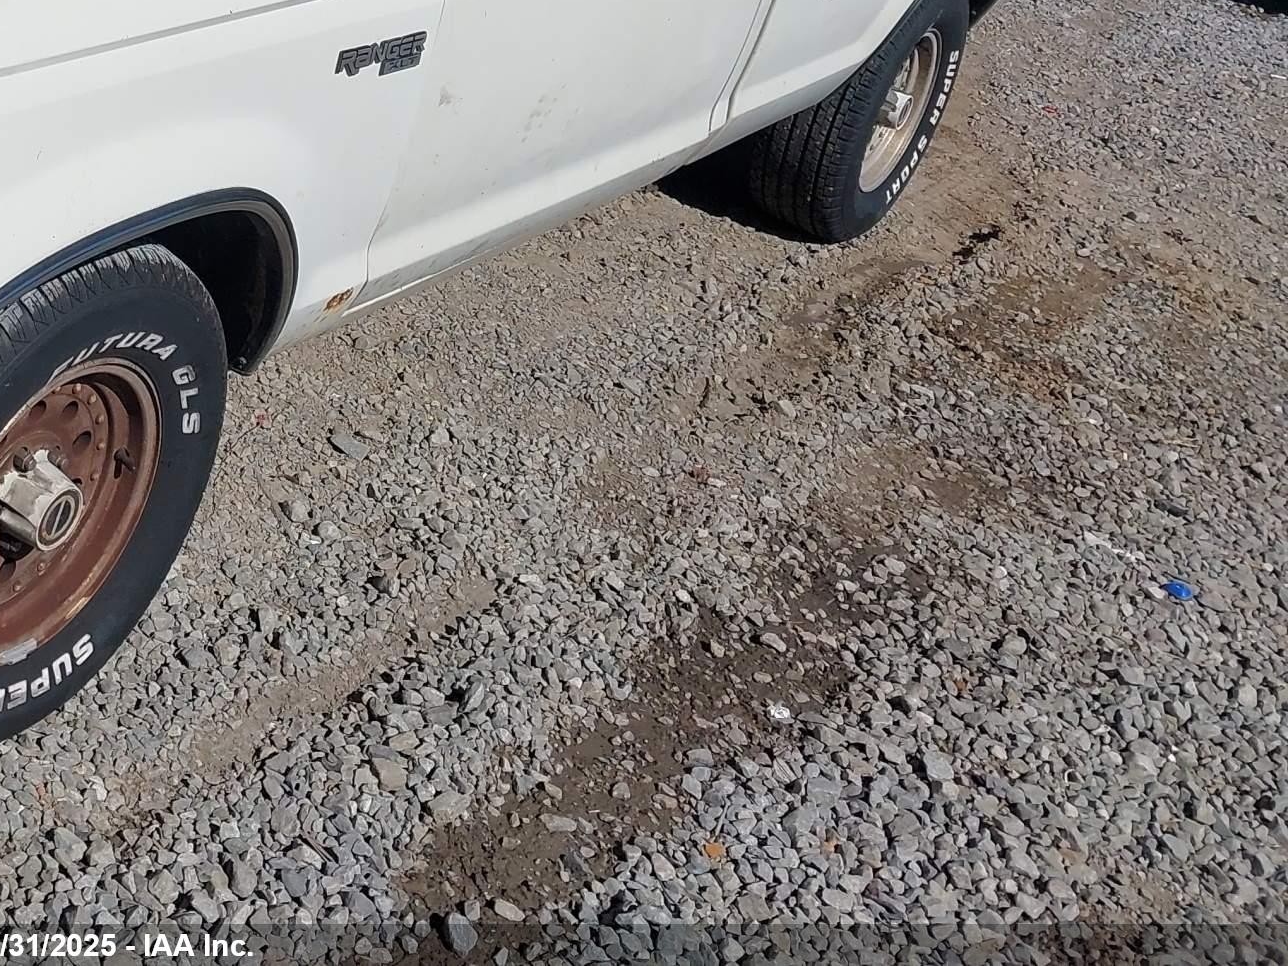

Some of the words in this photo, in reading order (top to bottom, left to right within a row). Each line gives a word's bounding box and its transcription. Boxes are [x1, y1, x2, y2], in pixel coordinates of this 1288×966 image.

[334, 30, 428, 77] RANGER
[929, 49, 960, 127] SUPER
[885, 134, 928, 205] SPORT
[171, 363, 201, 435] GLS
